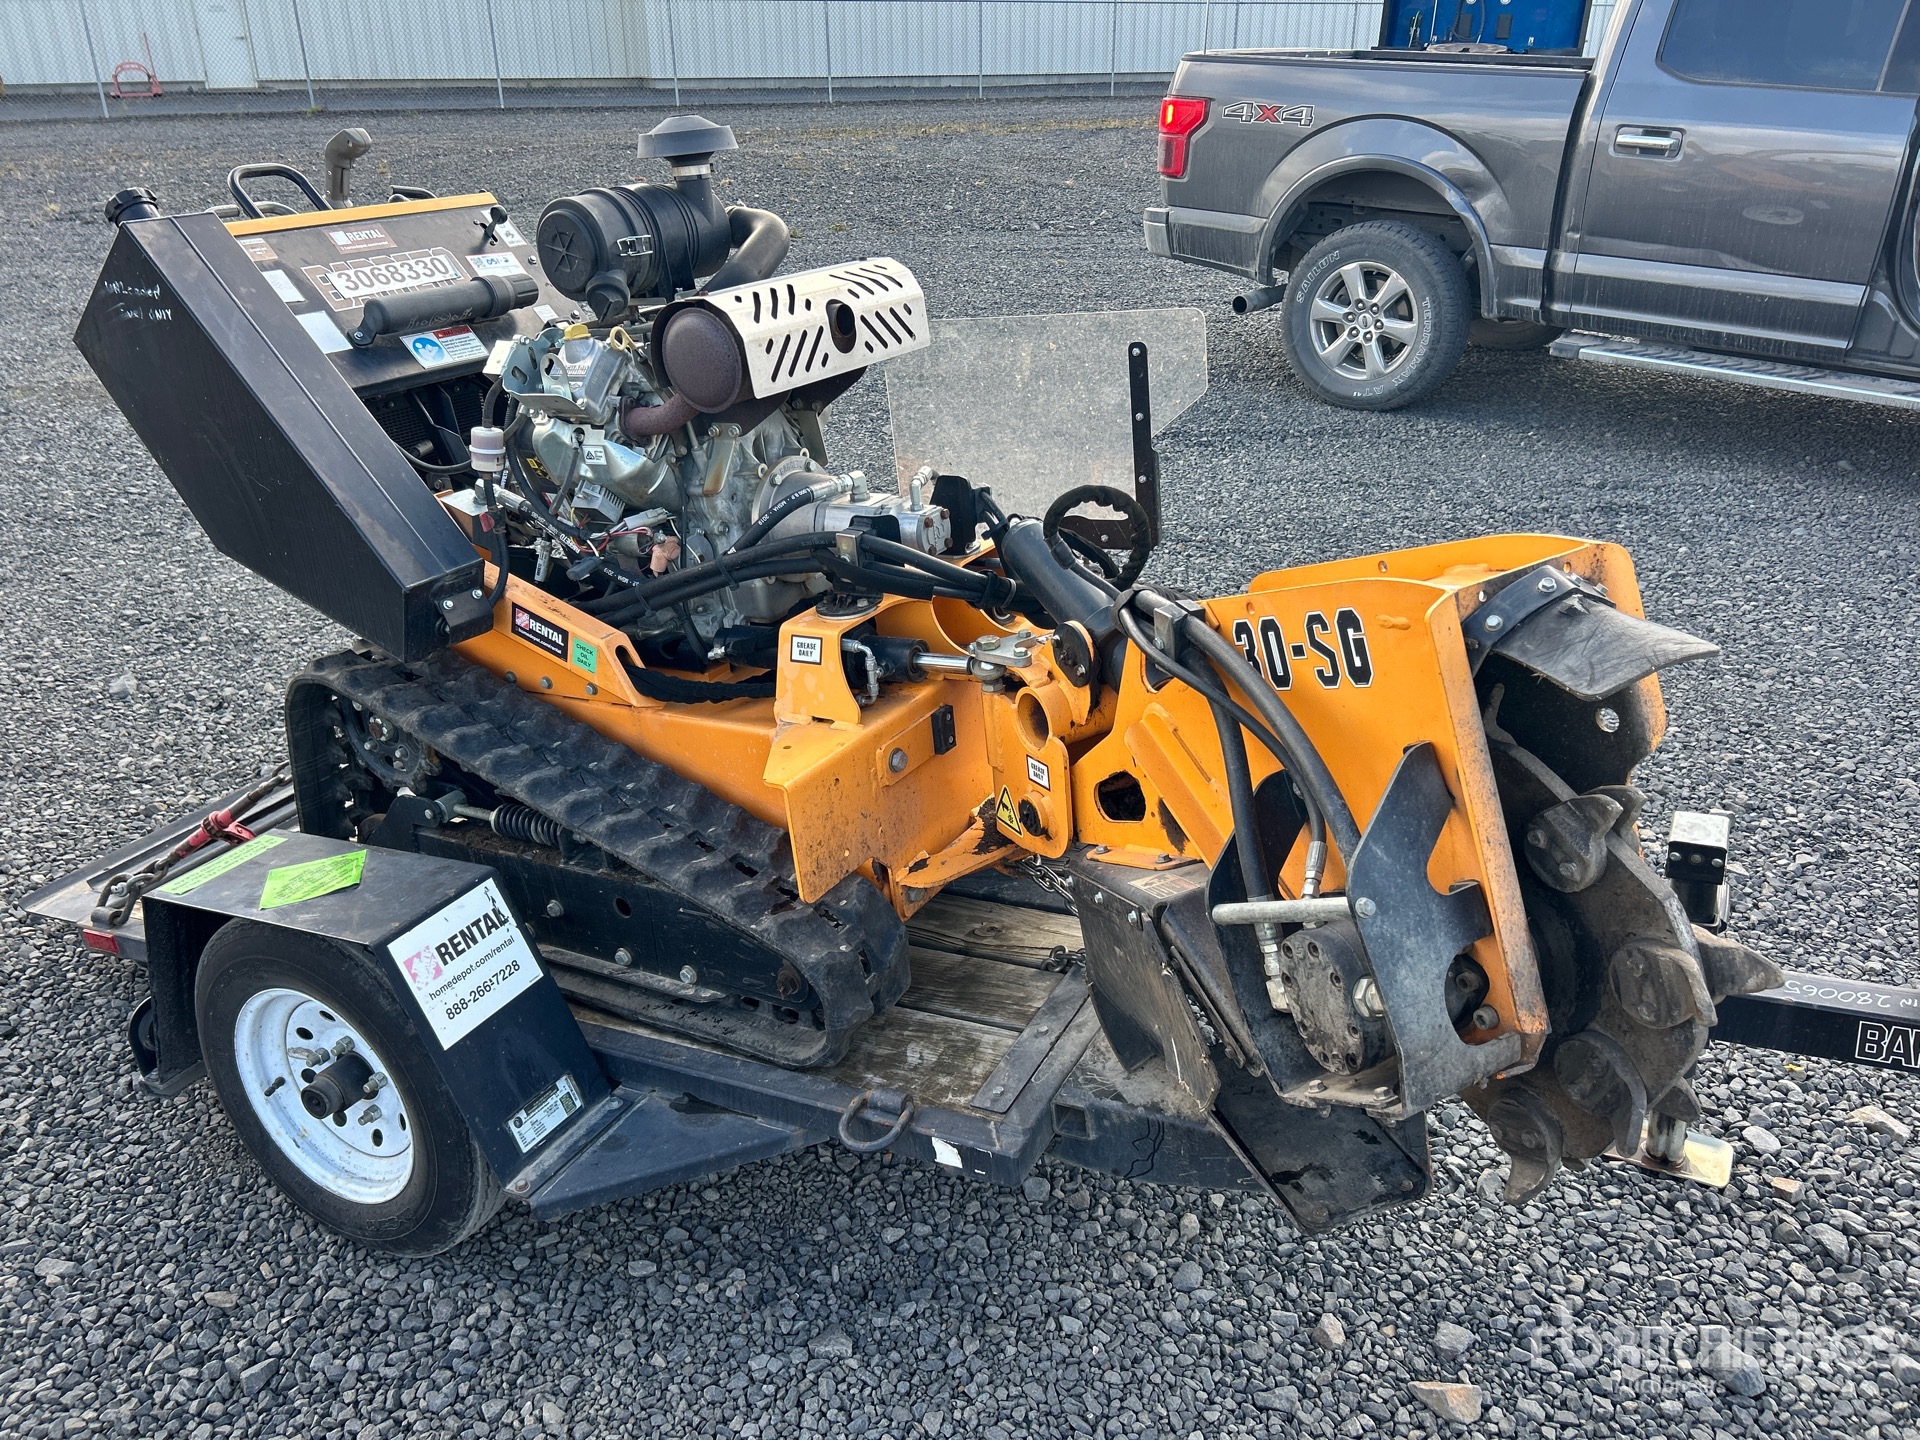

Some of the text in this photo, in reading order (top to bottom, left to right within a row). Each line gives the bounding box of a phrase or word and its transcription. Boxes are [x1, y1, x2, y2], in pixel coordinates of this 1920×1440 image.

[346, 229, 385, 242] RENTAL
[336, 257, 450, 291] 3068330
[1296, 250, 1340, 303] SAILUN
[1392, 297, 1432, 386] TERRAMAX
[529, 618, 564, 647] RENTAL
[796, 641, 817, 650] GREASE
[576, 643, 594, 656] CHECK
[576, 657, 591, 668] DAILY
[580, 652, 589, 661] OIL
[798, 649, 813, 657] DAILY
[1232, 607, 1374, 691] 30-SG
[434, 907, 509, 966] RENTAL
[428, 935, 515, 1001] homedepot.com/rental
[445, 959, 521, 1020] 888-266-7228
[1783, 979, 1891, 1008] 280065
